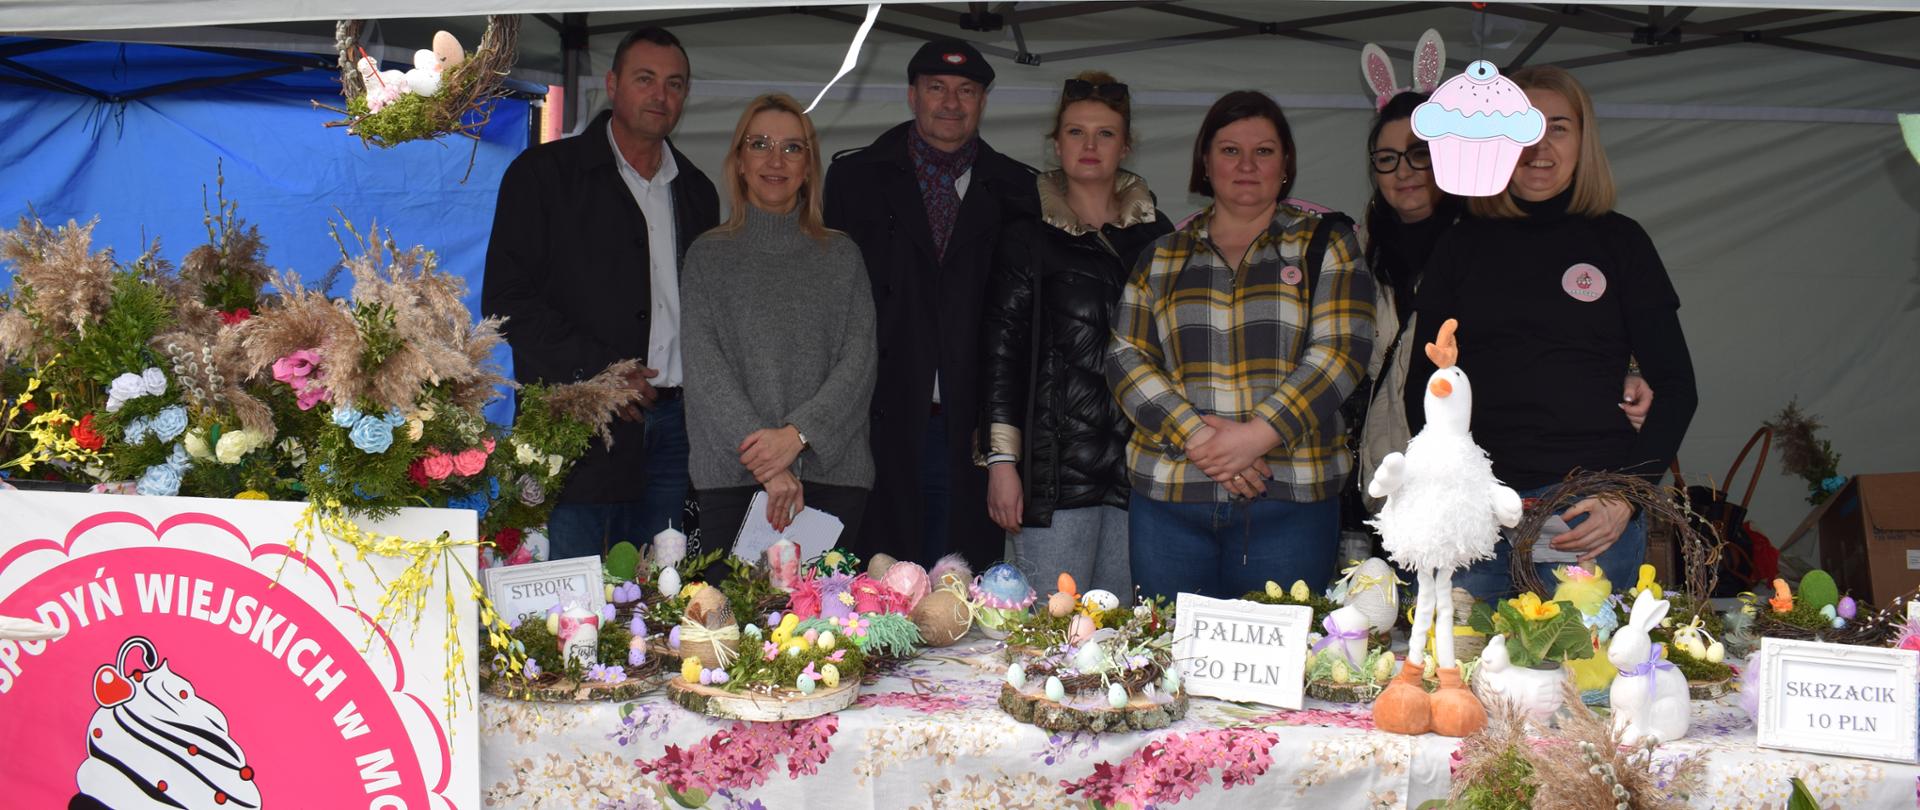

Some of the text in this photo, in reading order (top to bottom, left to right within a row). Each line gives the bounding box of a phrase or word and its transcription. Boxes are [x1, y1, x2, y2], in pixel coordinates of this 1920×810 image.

[134, 572, 347, 701] WIEJSKICH
[1193, 620, 1285, 646] PALMA
[1193, 659, 1280, 685] 20 PLN
[1786, 681, 1896, 703] SKRZACIK
[1807, 713, 1877, 732] 10 PLN
